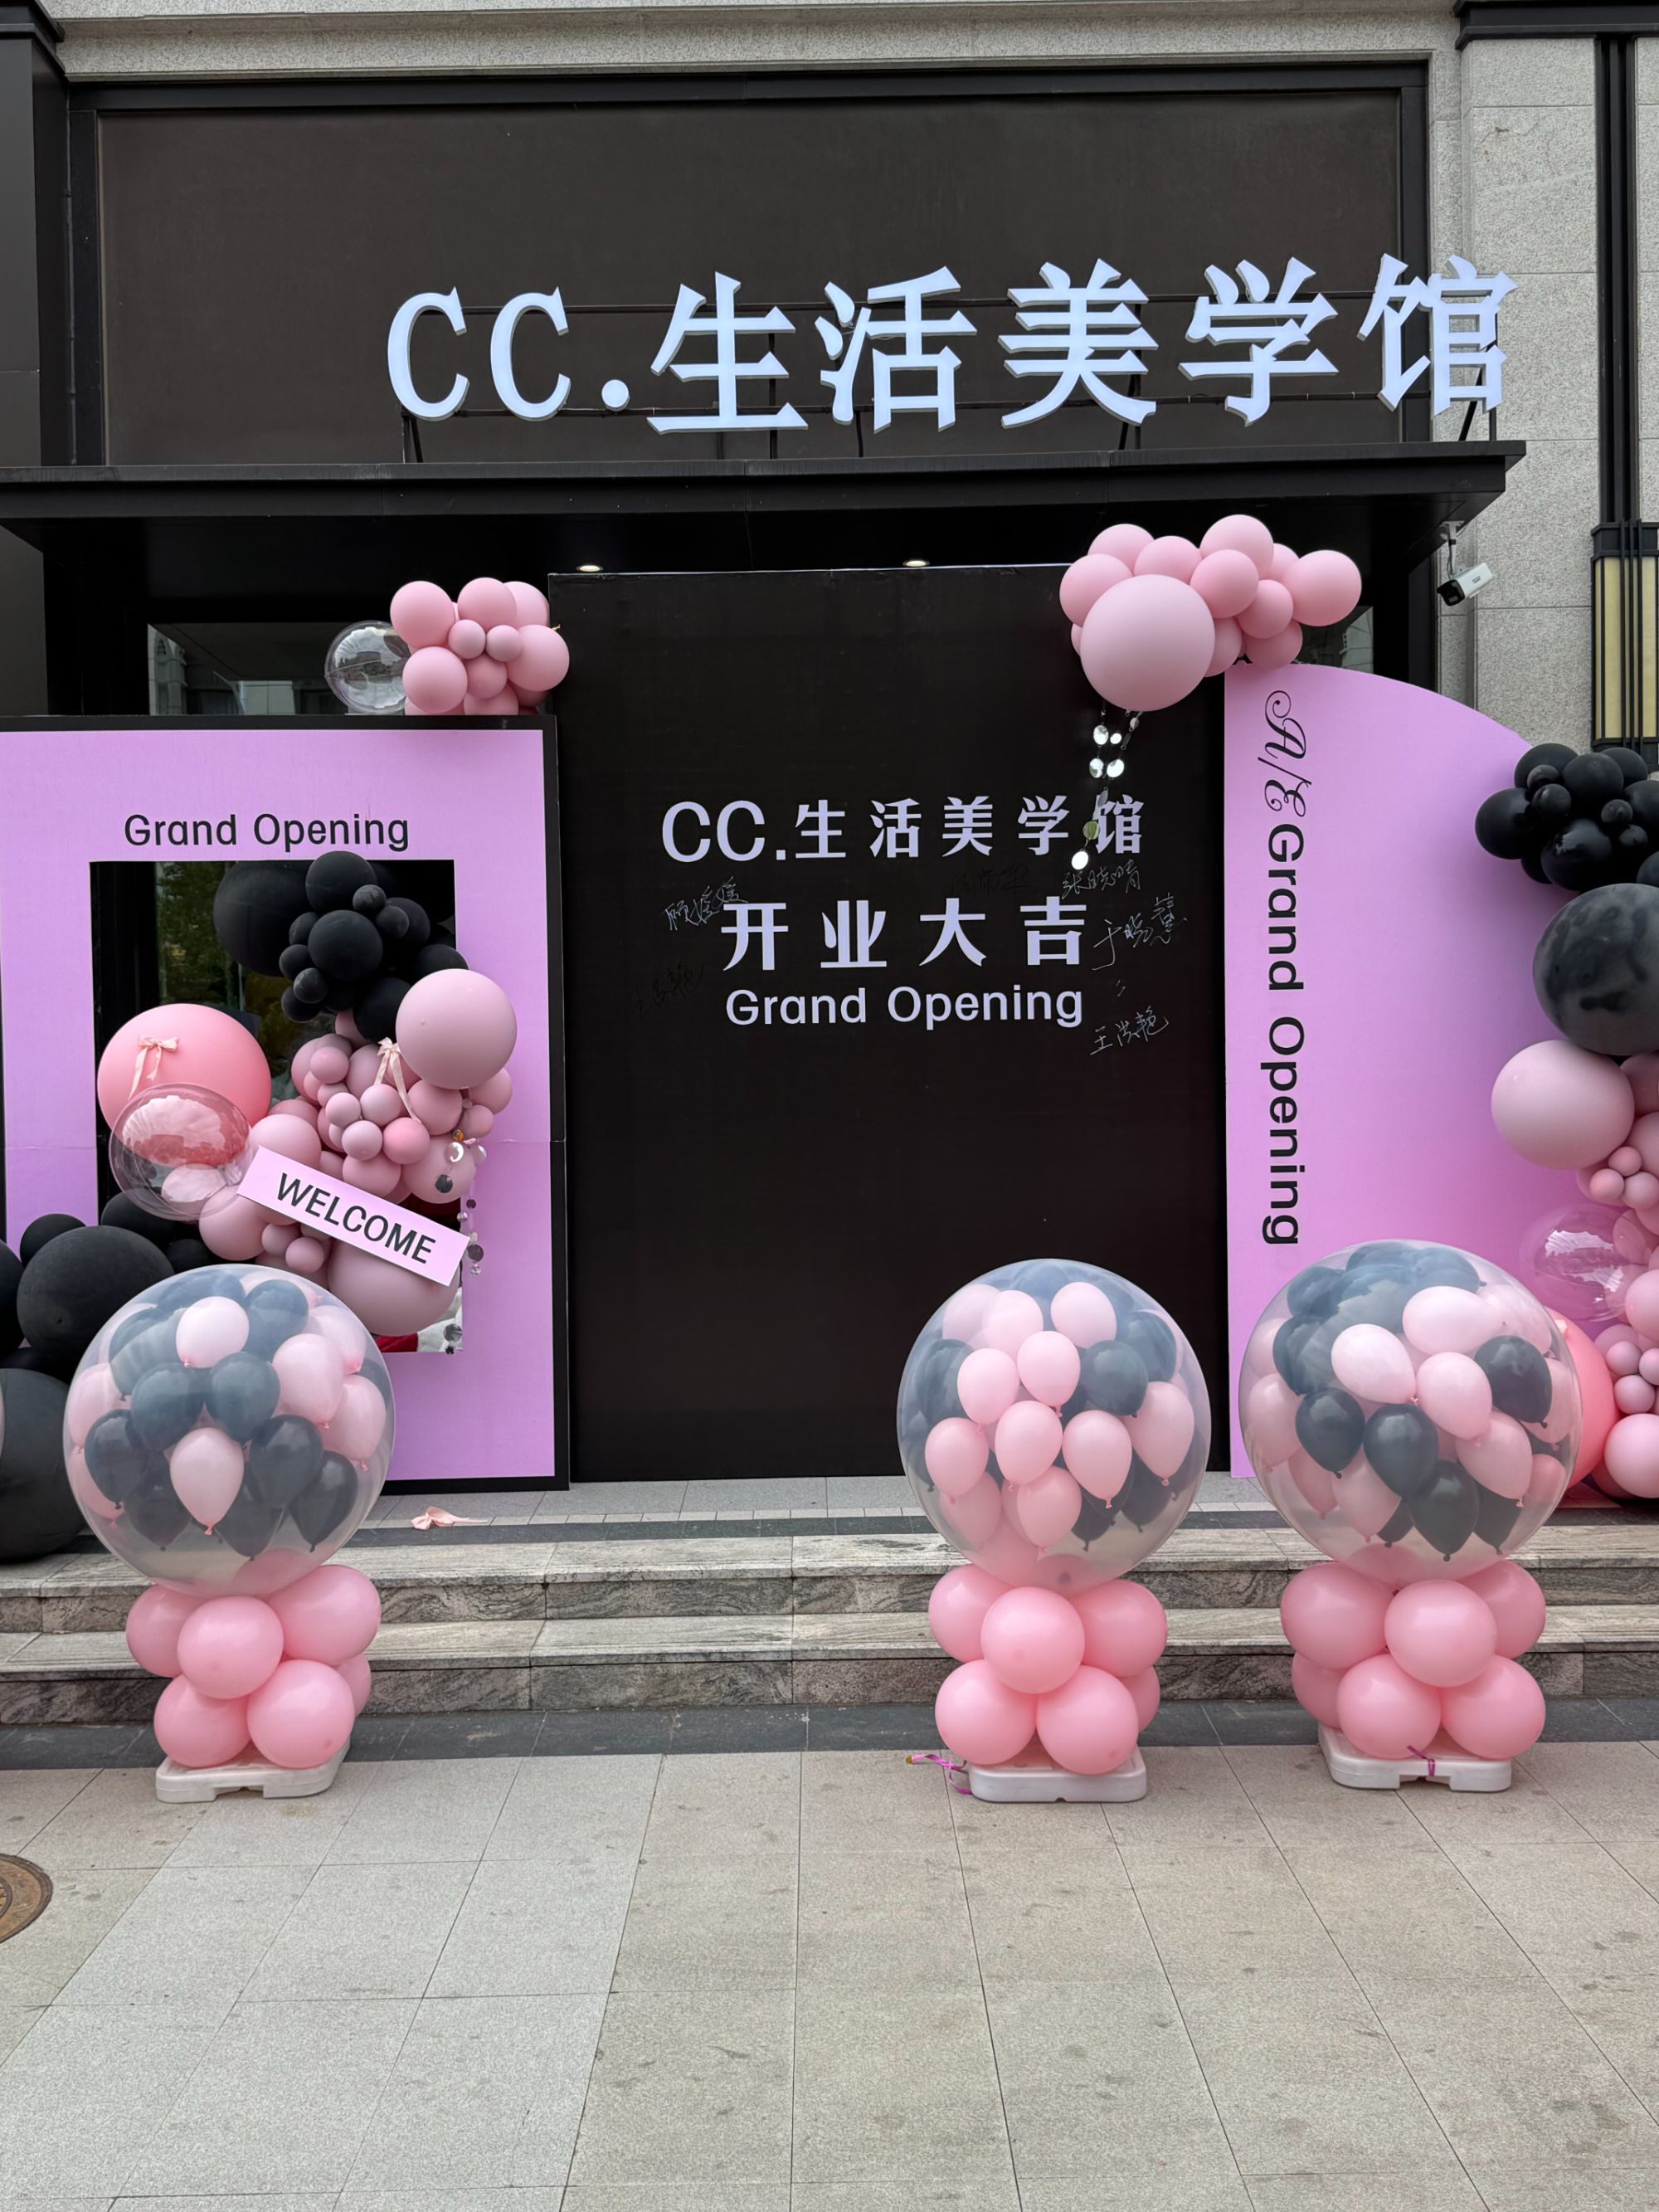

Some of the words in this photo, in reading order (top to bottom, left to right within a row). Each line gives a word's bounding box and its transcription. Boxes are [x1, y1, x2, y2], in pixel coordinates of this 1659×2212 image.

[387, 253, 1518, 433] CC.生活美学馆
[124, 813, 237, 846] Grand
[253, 813, 409, 853] Opening
[662, 794, 1145, 862] CC.生活美学馆
[720, 895, 1087, 972] 开业大吉
[1268, 822, 1305, 991] Grand
[726, 987, 867, 1026] Grand
[888, 984, 1082, 1030] Opening
[1260, 1016, 1306, 1245] Opening
[276, 1172, 437, 1265] WELCOME
